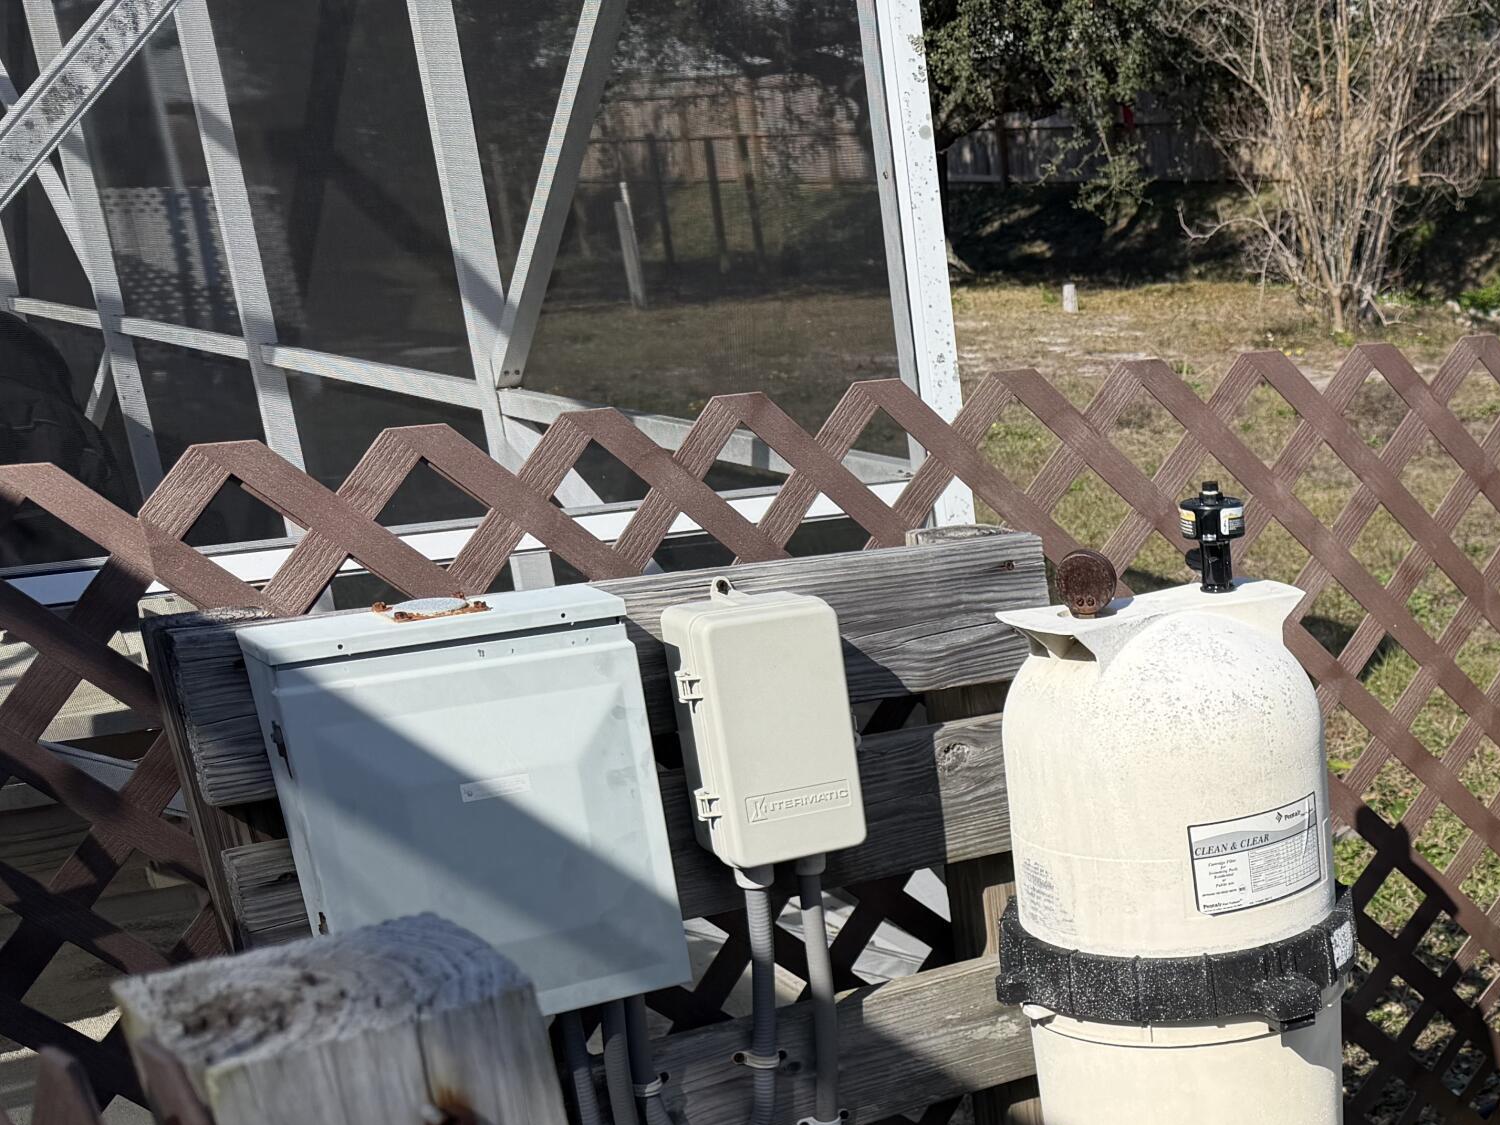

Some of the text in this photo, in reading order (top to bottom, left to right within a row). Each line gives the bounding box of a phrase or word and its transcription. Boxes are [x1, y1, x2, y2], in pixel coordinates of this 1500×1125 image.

[750, 789, 849, 823] INTERMATIC
[1194, 833, 1270, 857] CLEAN & CLEAR
